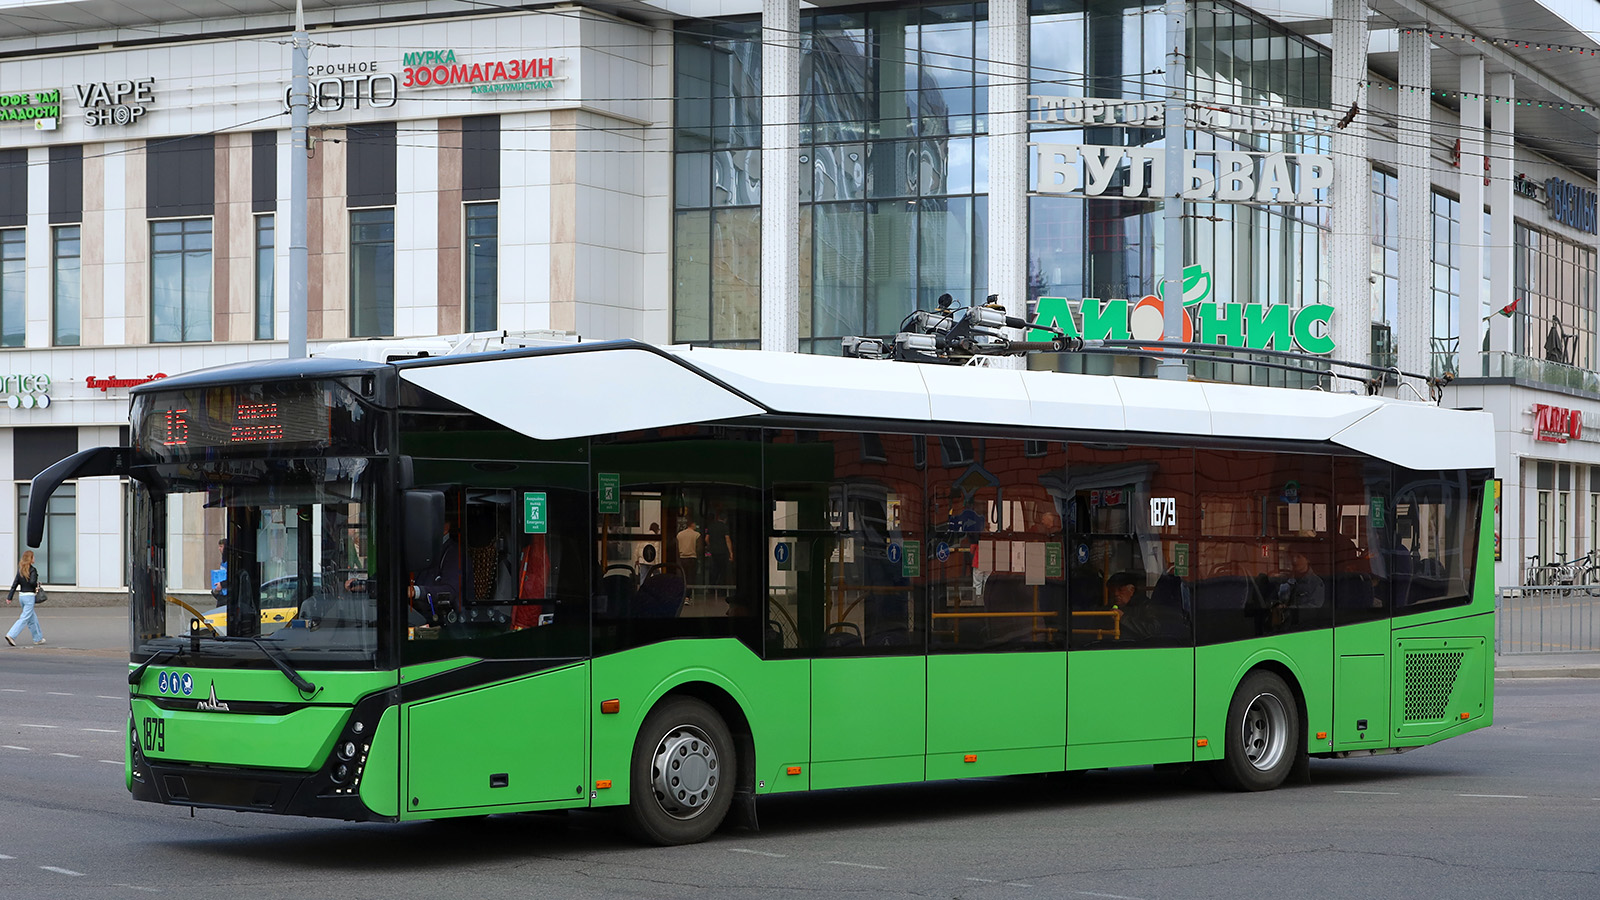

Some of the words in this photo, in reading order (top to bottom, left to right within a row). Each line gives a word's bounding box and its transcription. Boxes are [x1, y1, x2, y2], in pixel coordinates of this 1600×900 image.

[307, 61, 378, 76] СРОЧНОЕ
[402, 49, 457, 66] МУРКА
[402, 57, 554, 88] ЗООМАГАЗИН
[0, 93, 30, 108] ОФЕ
[34, 88, 60, 104] ЧАЙ
[72, 77, 155, 107] VAPE
[471, 80, 554, 94] АКВАРИУМИСТИКА
[84, 105, 147, 127] SHOP
[1037, 142, 1335, 202] БУЛЬВАР
[1150, 497, 1176, 526] 1879
[143, 717, 165, 752] 1879
